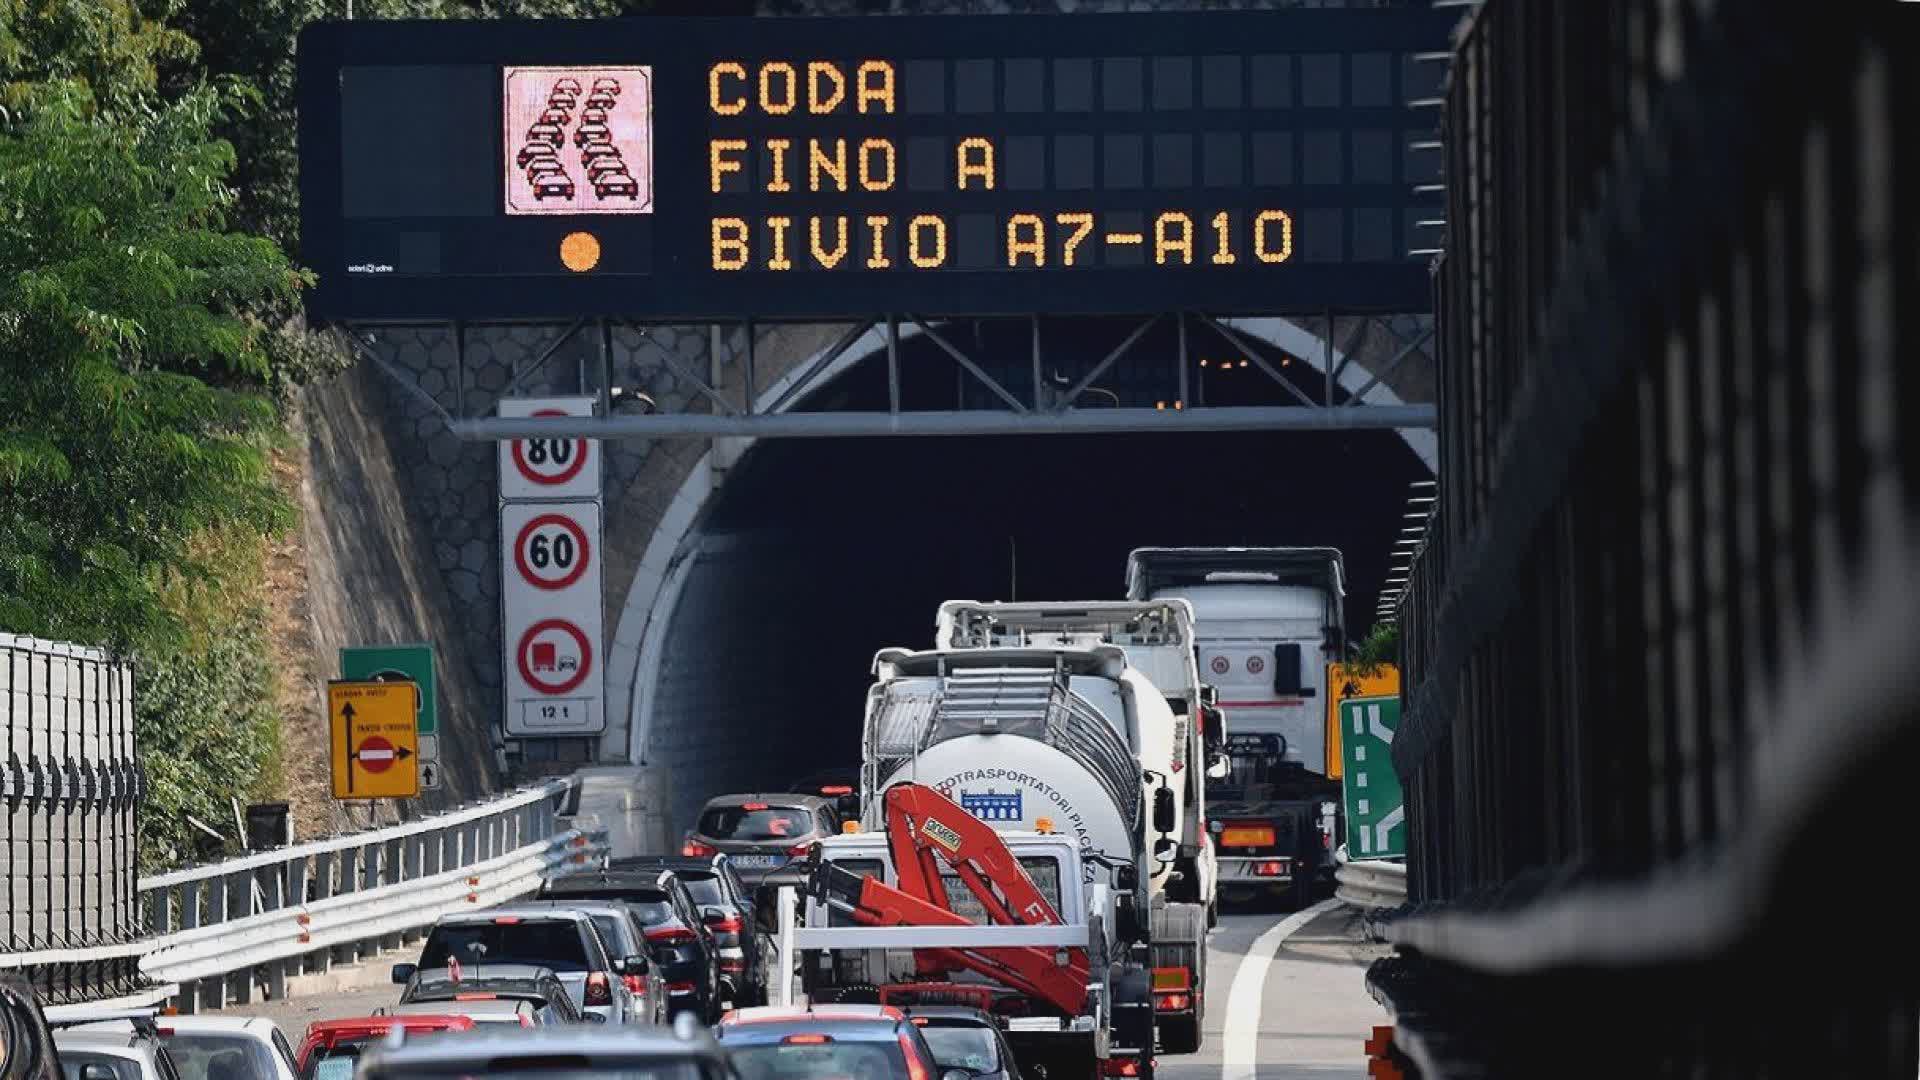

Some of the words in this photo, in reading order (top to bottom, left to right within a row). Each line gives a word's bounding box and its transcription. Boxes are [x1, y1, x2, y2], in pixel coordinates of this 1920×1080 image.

[709, 60, 895, 116] CODA
[710, 138, 896, 193] FINO
[957, 137, 994, 190] A
[711, 214, 947, 271] BIVIO
[1007, 209, 1292, 266] A7-A10
[528, 438, 571, 465] 80
[530, 533, 573, 569] 60
[542, 705, 556, 718] 12
[934, 768, 1072, 814] TOTRASPORTATORI
[1068, 812, 1097, 885] PIACEZA
